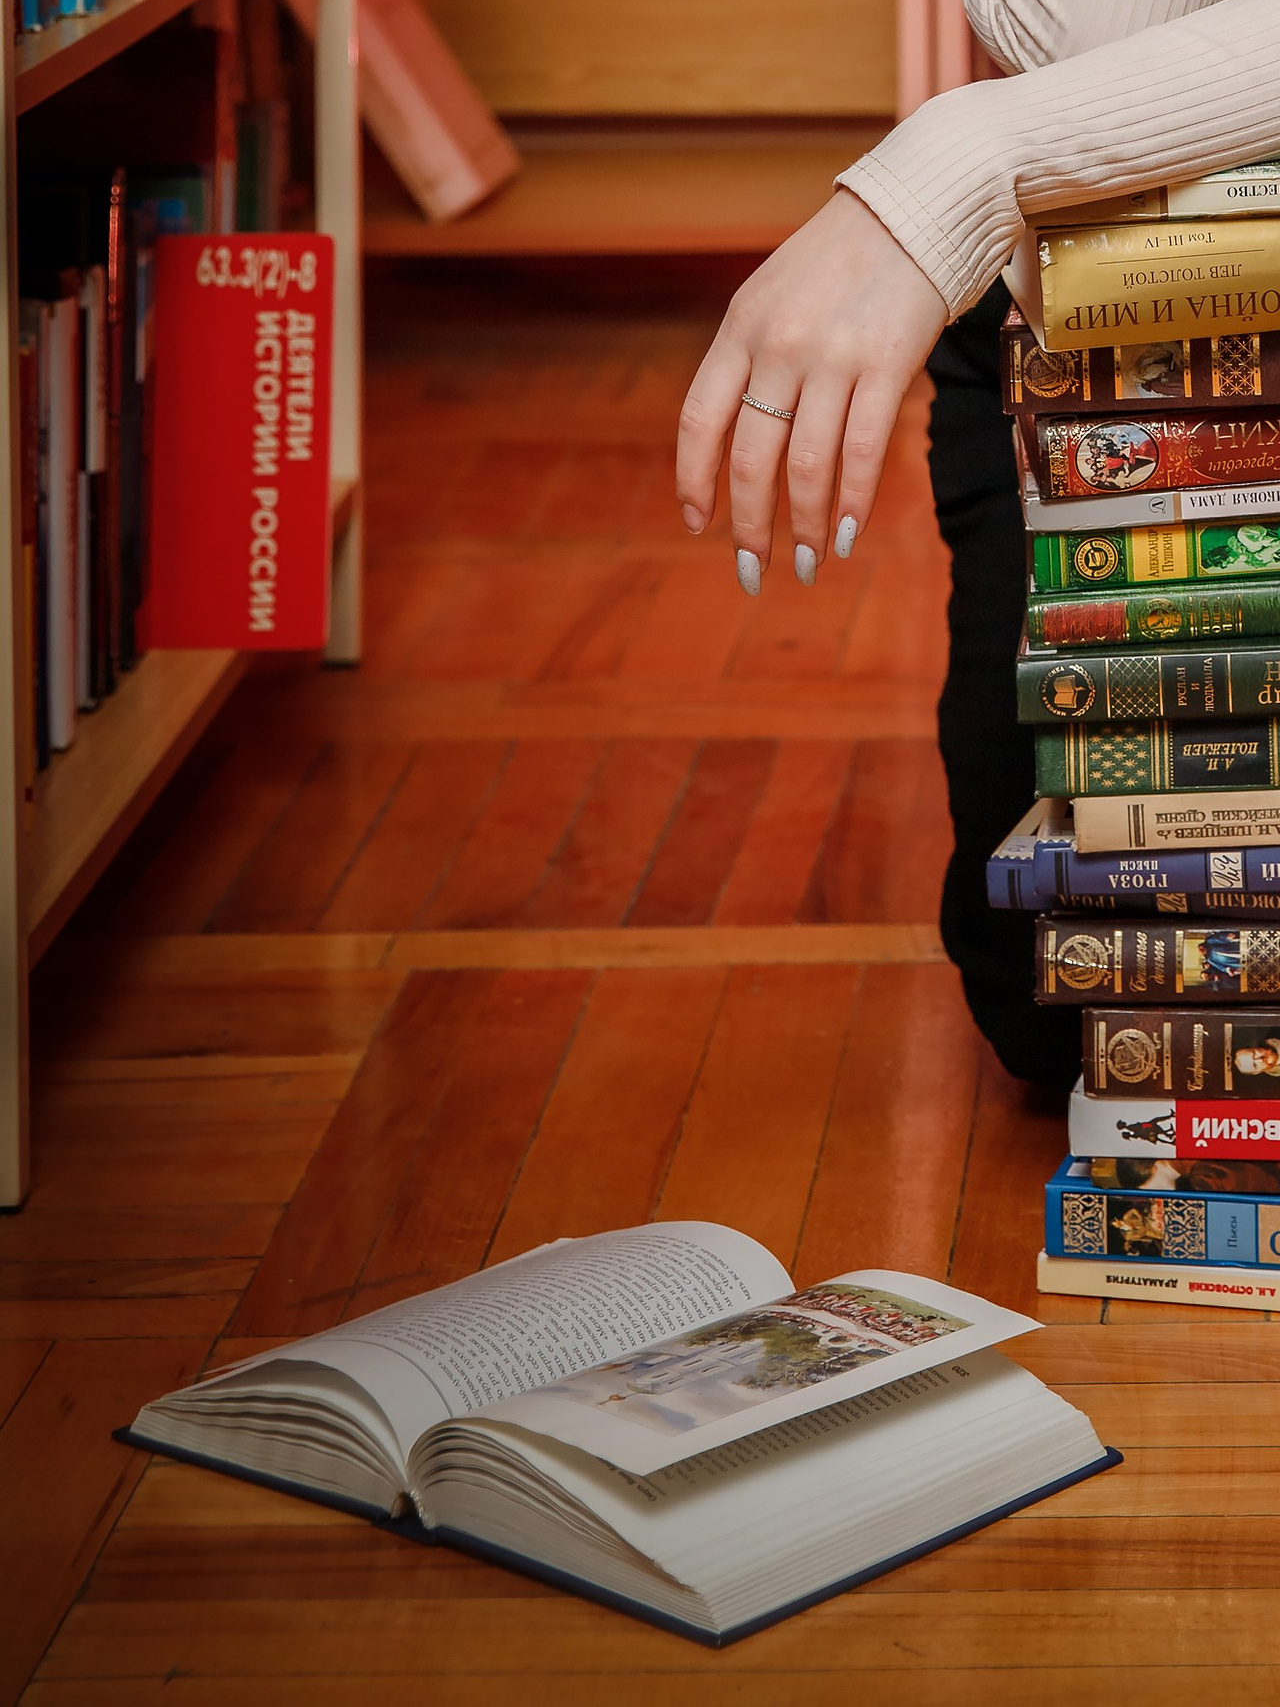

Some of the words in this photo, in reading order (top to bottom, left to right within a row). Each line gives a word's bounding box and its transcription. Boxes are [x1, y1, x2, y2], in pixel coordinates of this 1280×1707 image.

[1121, 266, 1206, 290] ТОЛСТОЙ
[1208, 263, 1243, 279] ЛЕВ
[1063, 300, 1140, 331] МИР
[1151, 298, 1176, 324] И
[252, 310, 284, 476] ИСТОРИИ
[285, 310, 316, 461] ДЕЯТЕЛИ
[1188, 492, 1228, 509] ДАМА
[248, 488, 280, 632] РОССИИ
[1176, 666, 1189, 707] РУСЛАН
[1190, 681, 1201, 691] И
[1202, 656, 1216, 714] ЛЮДМИЛА
[1181, 741, 1260, 757] ПОЛЕЖАЕВ
[1154, 810, 1206, 825] СЦЕНЫ
[1173, 823, 1253, 840] ПЛЕЩЕЕВ
[1118, 859, 1159, 872] ПЬЕСЫ
[1107, 873, 1169, 890] ГРОЗА
[1226, 1214, 1239, 1249] Пьесы
[686, 1267, 724, 1313] невыносимо
[738, 1281, 753, 1301] мать
[1104, 1273, 1179, 1290] ДРАМАТУРГИЯ
[1187, 1280, 1254, 1297] ОСТРОВСКИЙ
[674, 1296, 695, 1324] голоса
[559, 1345, 579, 1372] кроме
